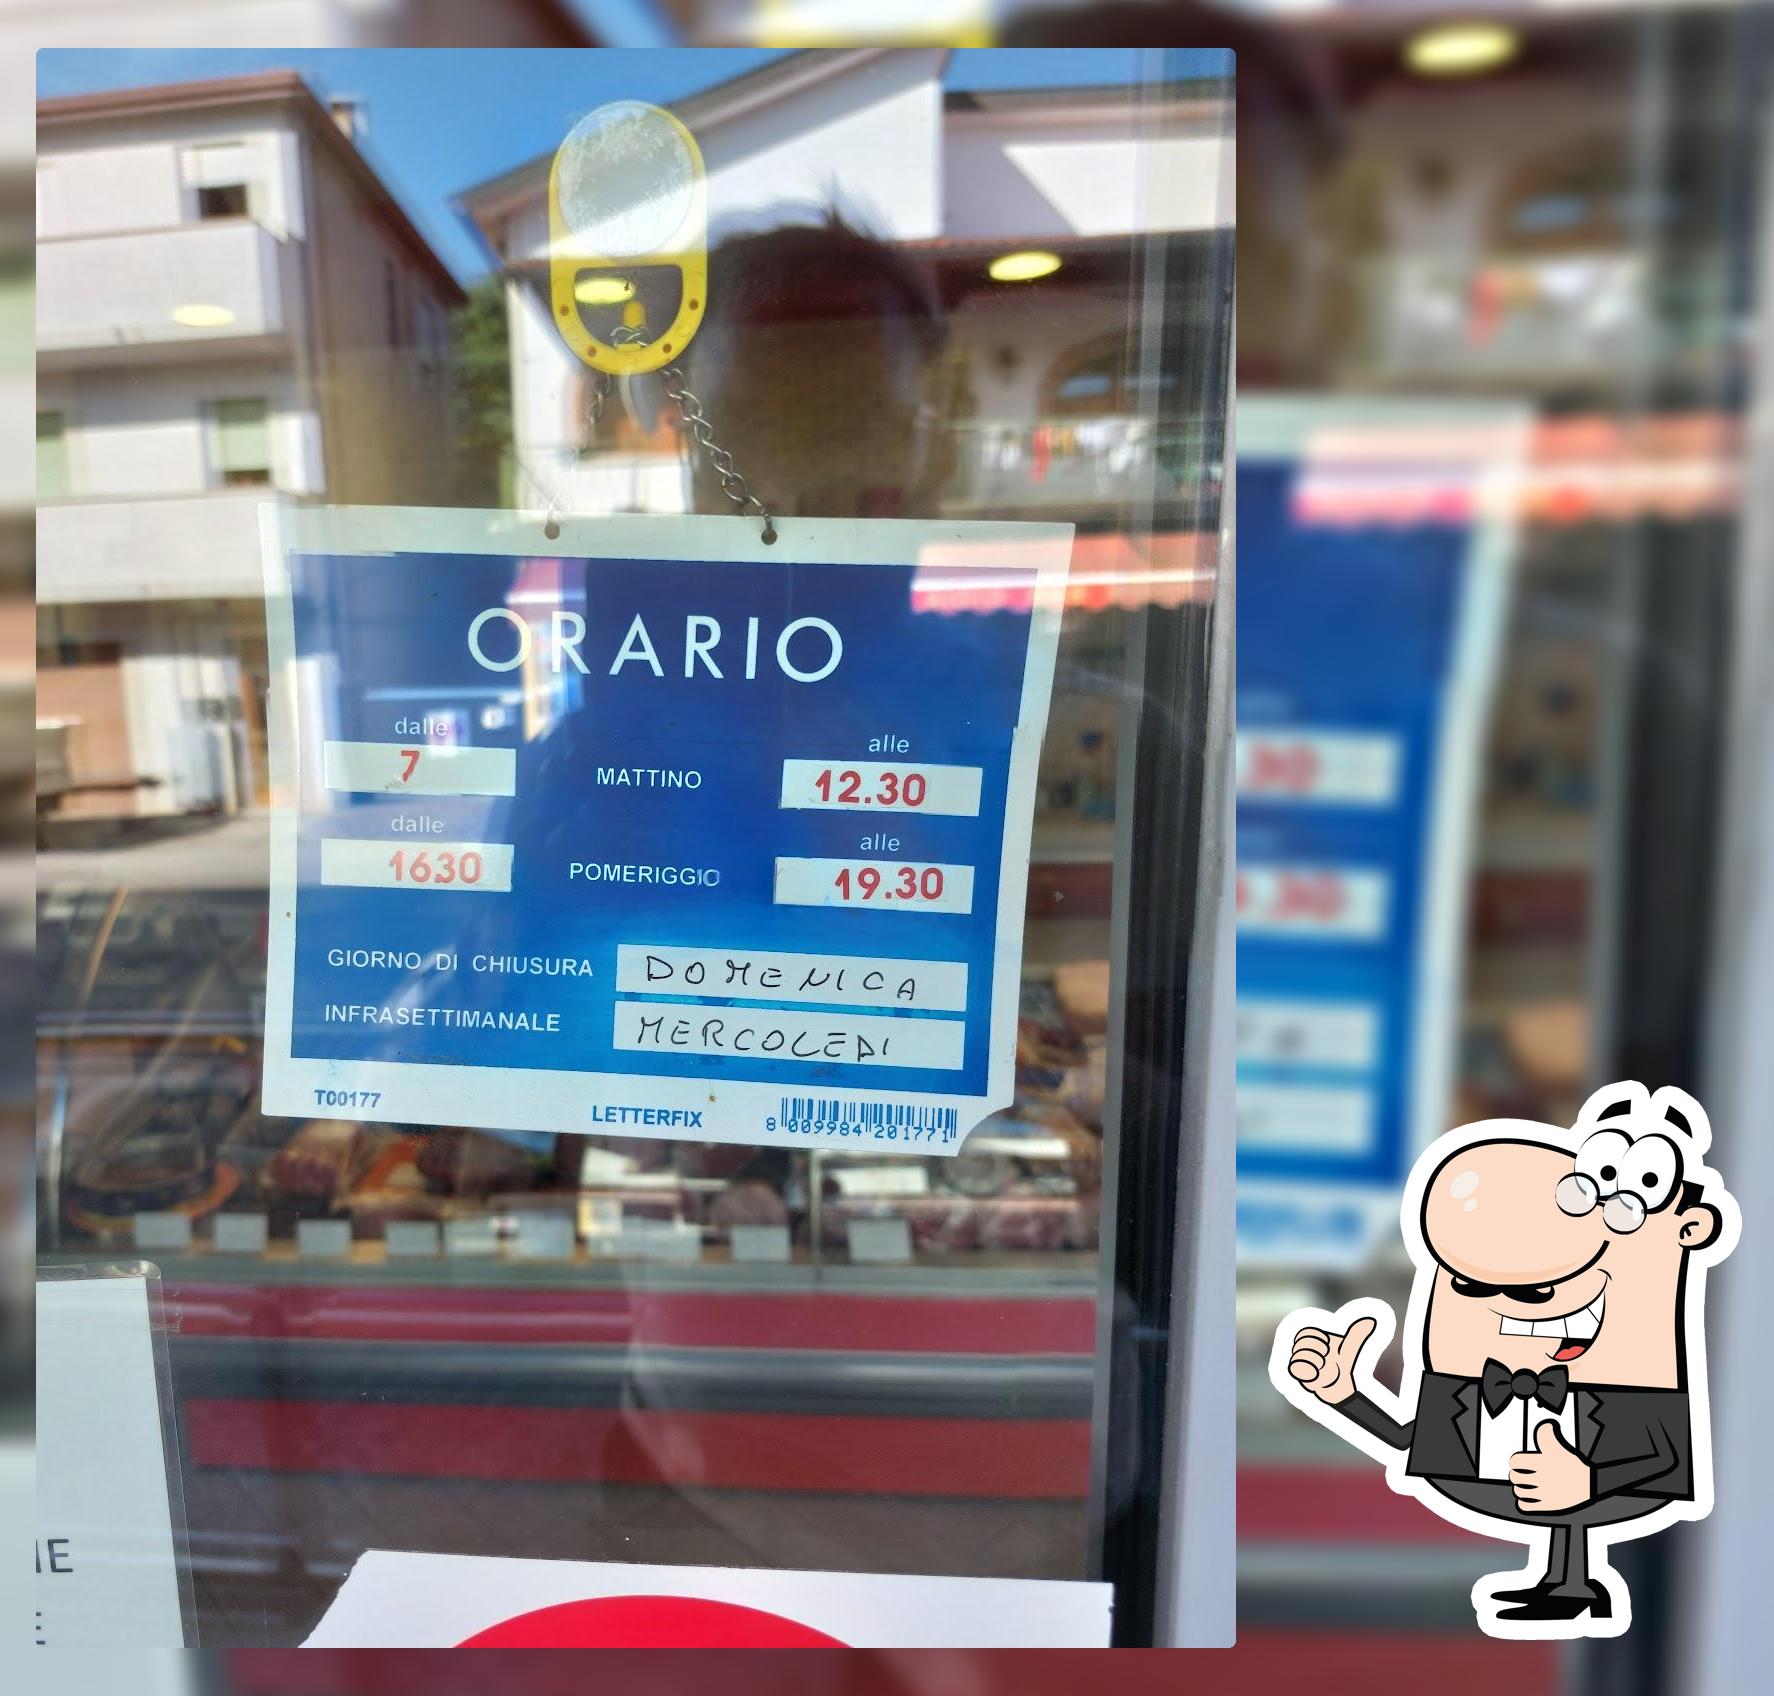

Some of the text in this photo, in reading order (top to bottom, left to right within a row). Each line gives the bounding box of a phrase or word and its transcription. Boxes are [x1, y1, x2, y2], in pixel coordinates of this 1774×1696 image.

[468, 607, 843, 683] ORARIO
[394, 717, 449, 737] dalle
[868, 734, 910, 754] alle
[400, 750, 420, 783] 7
[597, 767, 702, 790] MATTINO
[814, 769, 927, 807] 12.30
[391, 814, 445, 834] dalle
[860, 833, 901, 852] alle
[569, 862, 720, 887] POMERIGGIO
[834, 866, 944, 901] 19.30
[327, 949, 594, 977] GIORNO DI CHIUSURA
[646, 955, 916, 1001] DOMENICA
[324, 1003, 561, 1032] INFRASETTIMANALE
[637, 1015, 891, 1062] MERCOLEDI
[314, 1088, 382, 1109] T00177
[591, 1105, 703, 1129] LETTERFIX
[766, 1116, 777, 1132] 8
